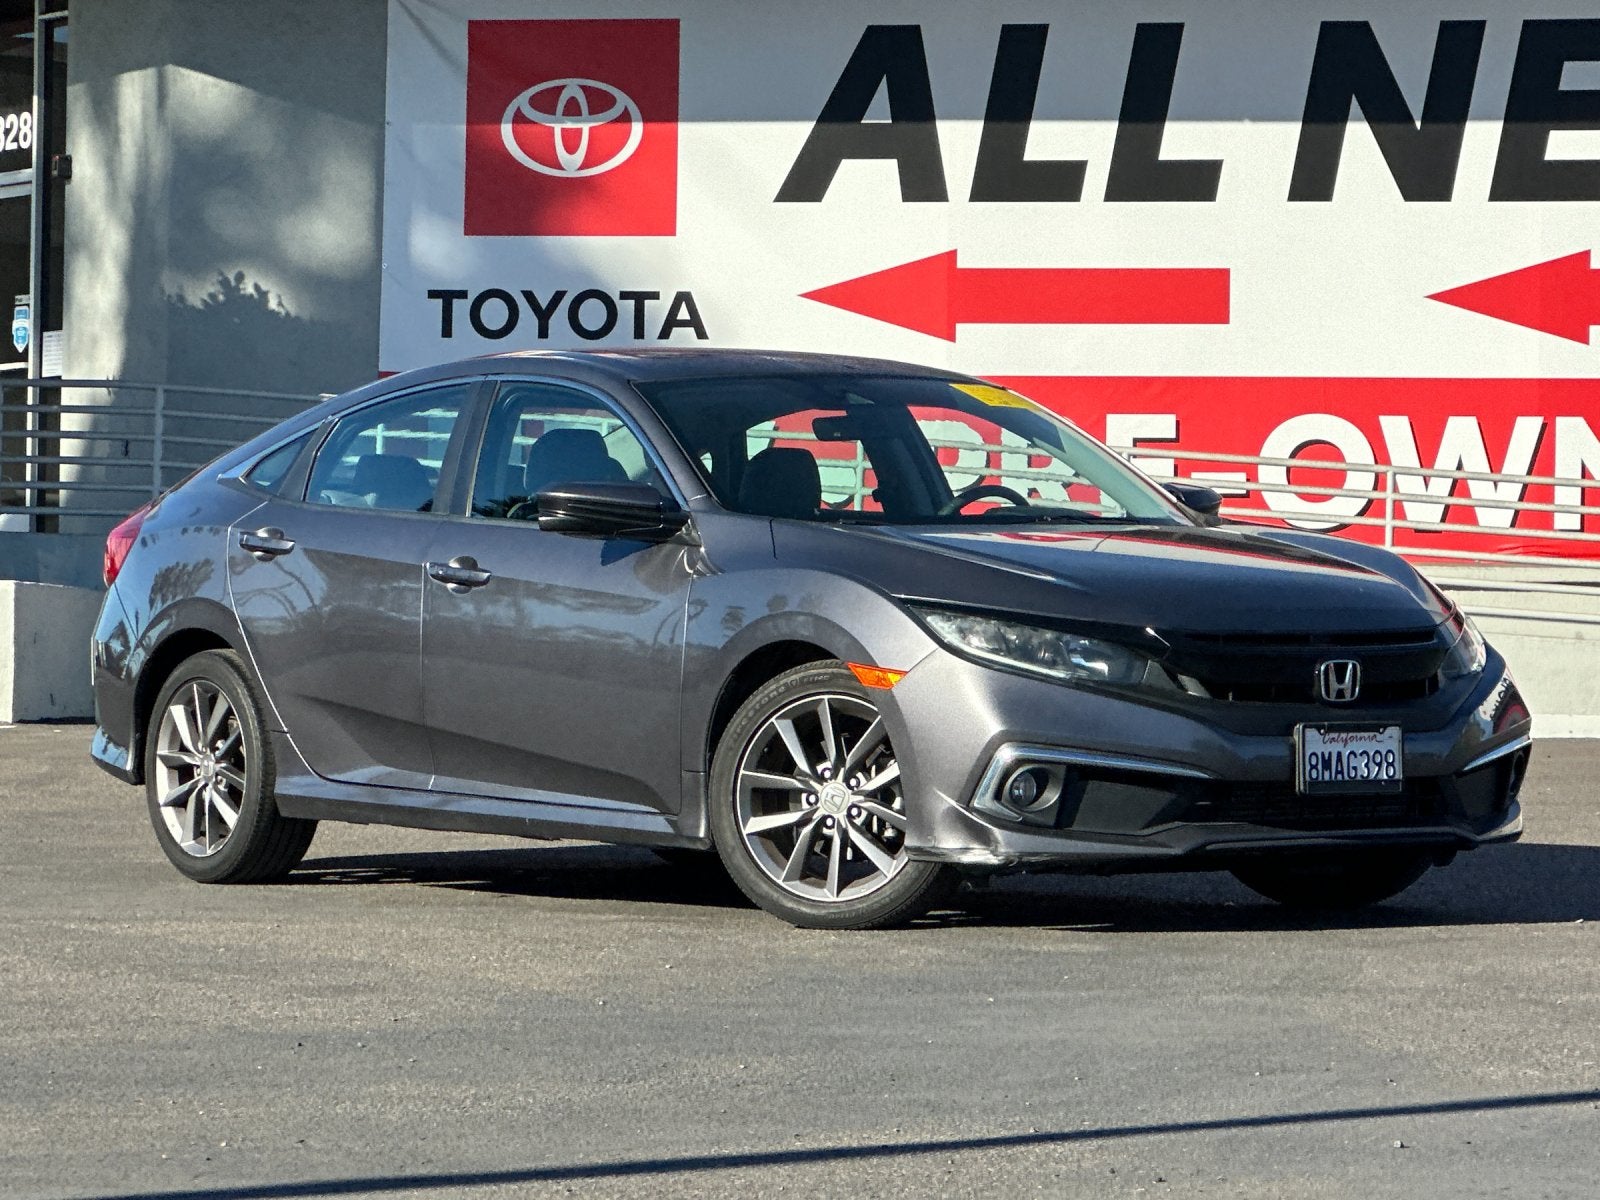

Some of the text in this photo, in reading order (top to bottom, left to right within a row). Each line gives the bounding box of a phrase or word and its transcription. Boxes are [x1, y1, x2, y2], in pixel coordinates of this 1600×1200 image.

[773, 19, 1600, 202] ALL NE
[427, 287, 710, 341] TOYOTA
[1321, 731, 1384, 749] California
[1307, 748, 1397, 781] 8MAG398
